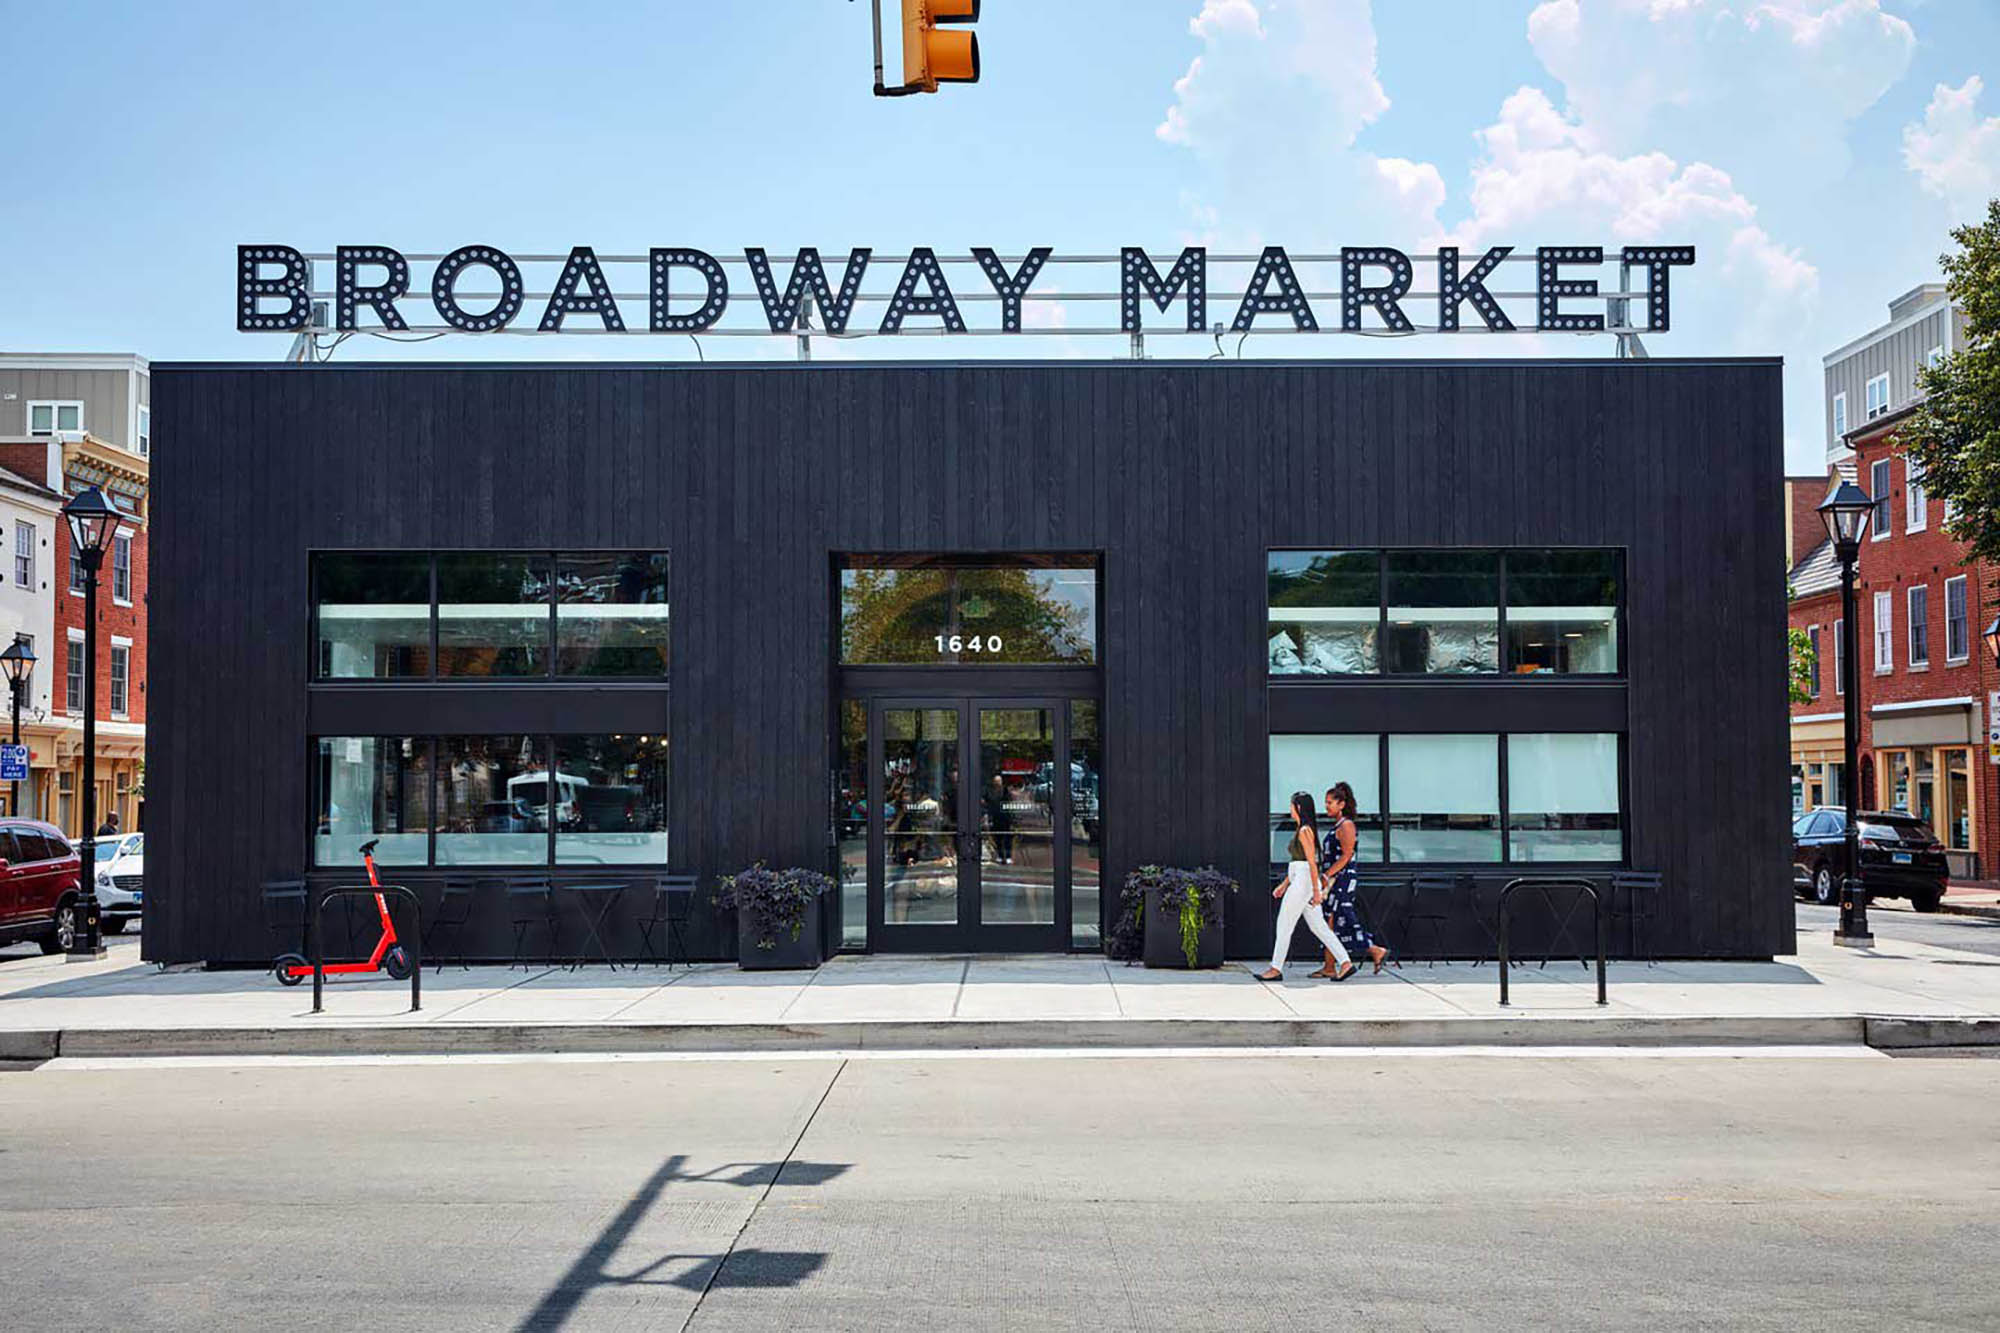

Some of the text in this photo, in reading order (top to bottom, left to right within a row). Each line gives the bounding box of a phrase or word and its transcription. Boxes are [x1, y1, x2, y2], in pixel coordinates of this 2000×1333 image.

[237, 244, 1696, 334] BROADWAY MARKET
[934, 635, 1003, 653] 1640
